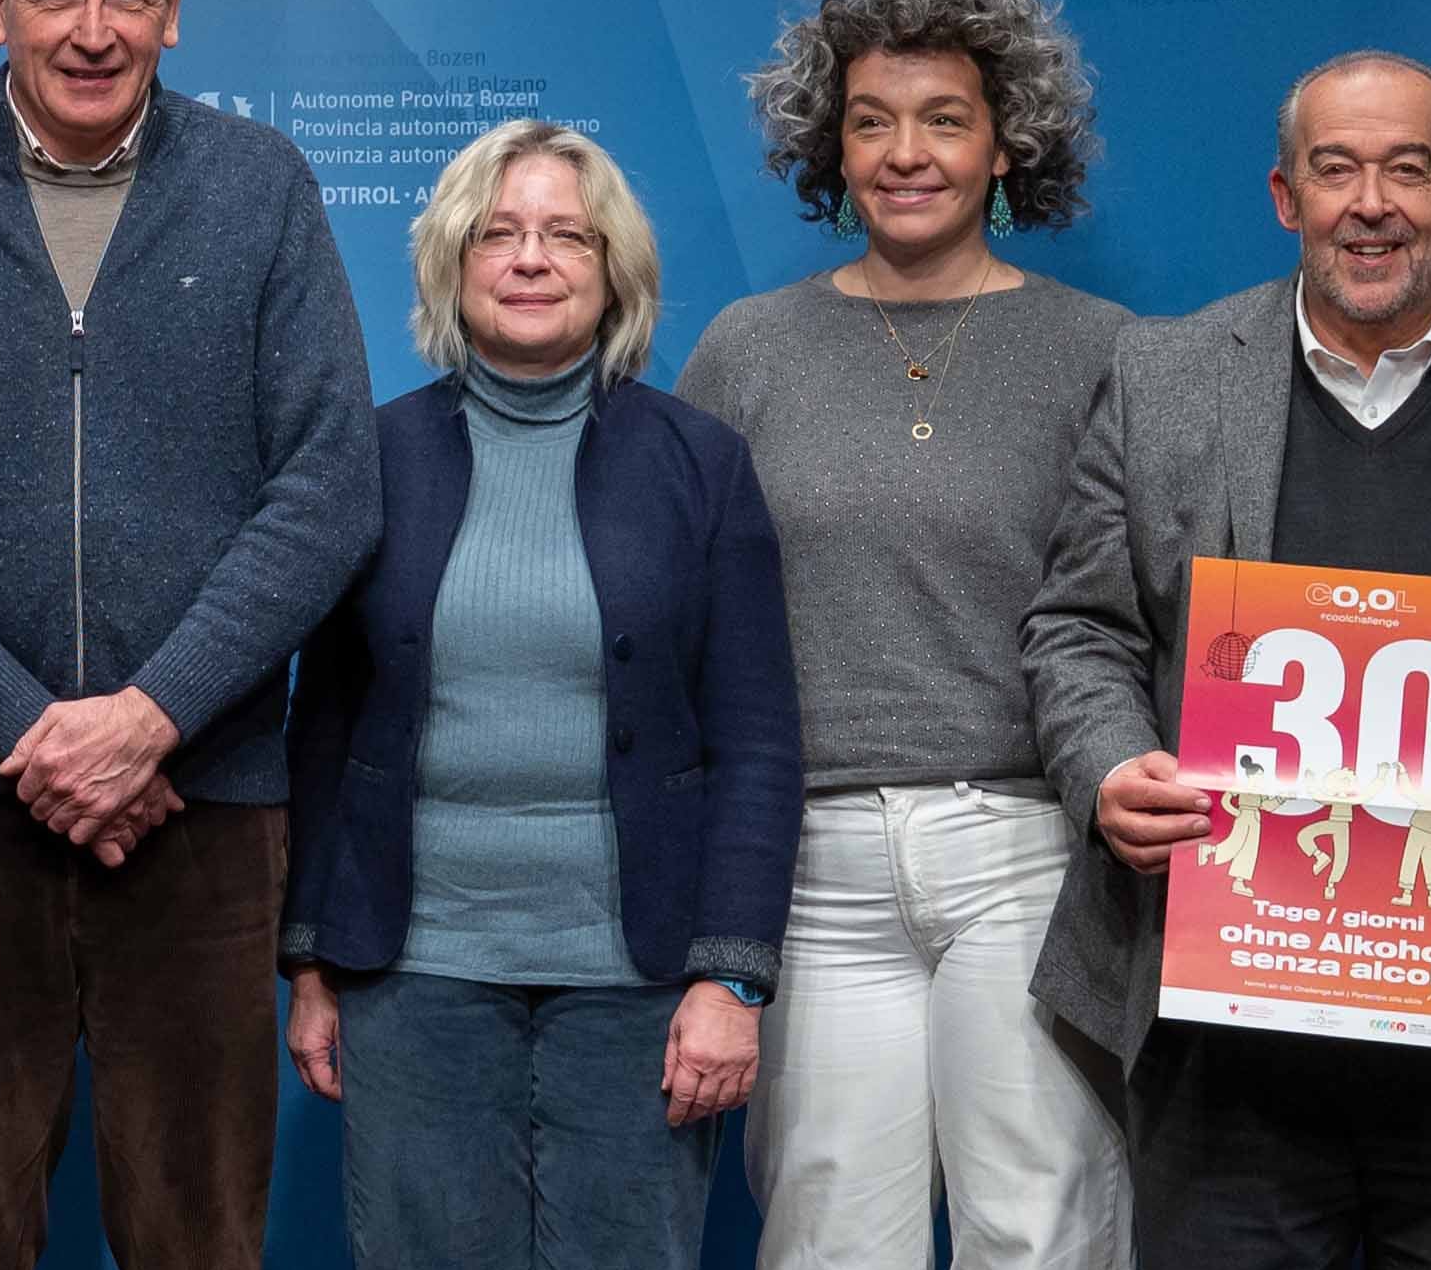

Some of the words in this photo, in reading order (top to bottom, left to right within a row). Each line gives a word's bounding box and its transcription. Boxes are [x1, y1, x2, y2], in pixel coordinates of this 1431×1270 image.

[291, 92, 394, 109] Autonome
[402, 90, 473, 108] Provinz
[480, 89, 538, 106] Bozen
[293, 118, 382, 136] Provincia
[390, 119, 487, 137] autonoma
[1253, 900, 1320, 922] Tage
[1343, 911, 1424, 931] giorni
[1220, 924, 1310, 949] ohne
[1231, 950, 1340, 976] senza
